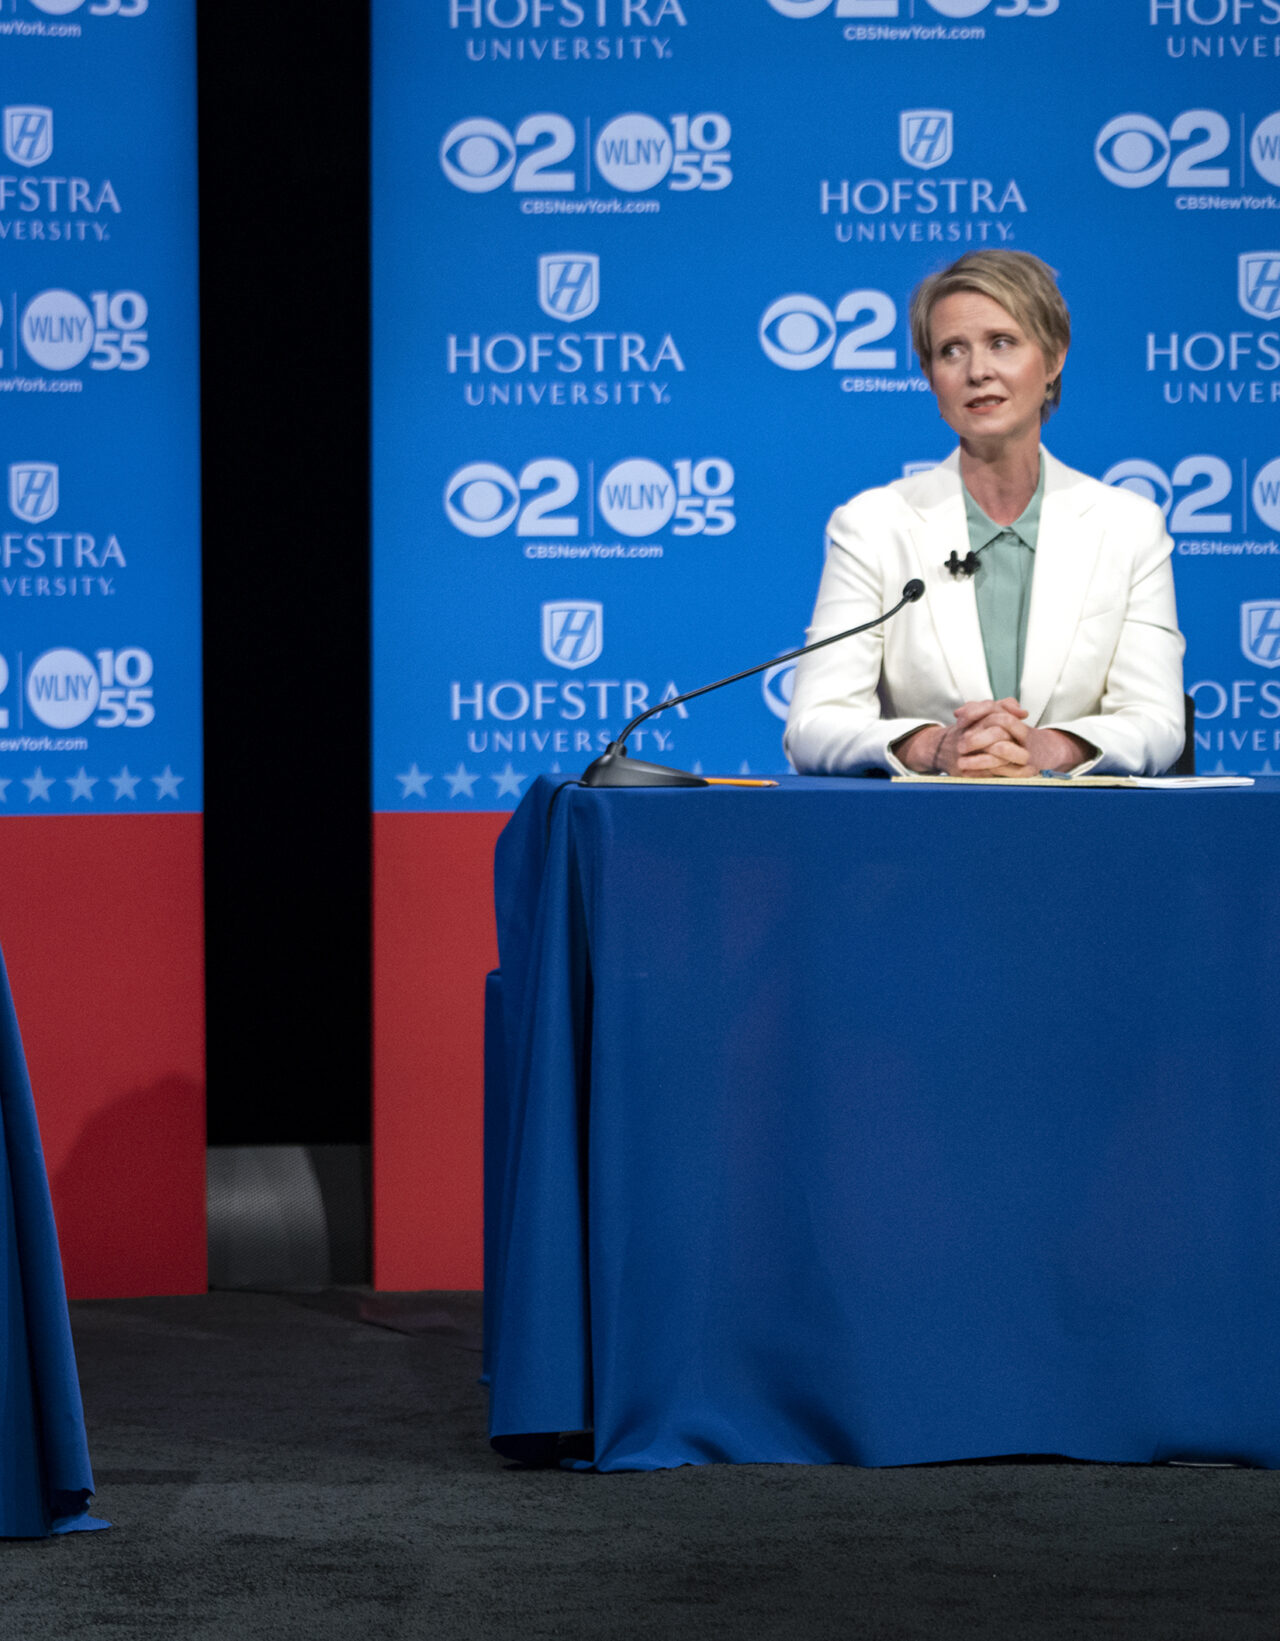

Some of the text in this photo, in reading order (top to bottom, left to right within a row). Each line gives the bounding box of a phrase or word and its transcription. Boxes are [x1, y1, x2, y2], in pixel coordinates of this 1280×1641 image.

[450, 0, 687, 28] HOFSTRA
[844, 25, 985, 40] CBSNewYork.com
[514, 113, 666, 191] 2 WLNY
[669, 113, 731, 152] 10
[1167, 109, 1230, 187] 2
[669, 151, 732, 190] 55
[521, 199, 660, 214] CBSNewYork.com
[821, 179, 1027, 214] HOFSTRA
[29, 316, 87, 343] WLNY
[91, 291, 147, 332] 10
[834, 290, 896, 369] 2
[88, 331, 149, 370] 55
[448, 333, 685, 373] HOFSTRA
[517, 458, 670, 536] 2 WLNY
[672, 458, 734, 498] 10
[1170, 454, 1232, 533] 2
[672, 497, 735, 535] 55
[524, 544, 663, 558] CBSNewYork.com
[94, 648, 152, 687] 10
[33, 674, 93, 703] WLNY
[94, 686, 154, 727] 55
[452, 681, 688, 720] HOFSTRA
[468, 731, 673, 753] UNIVERSTY
